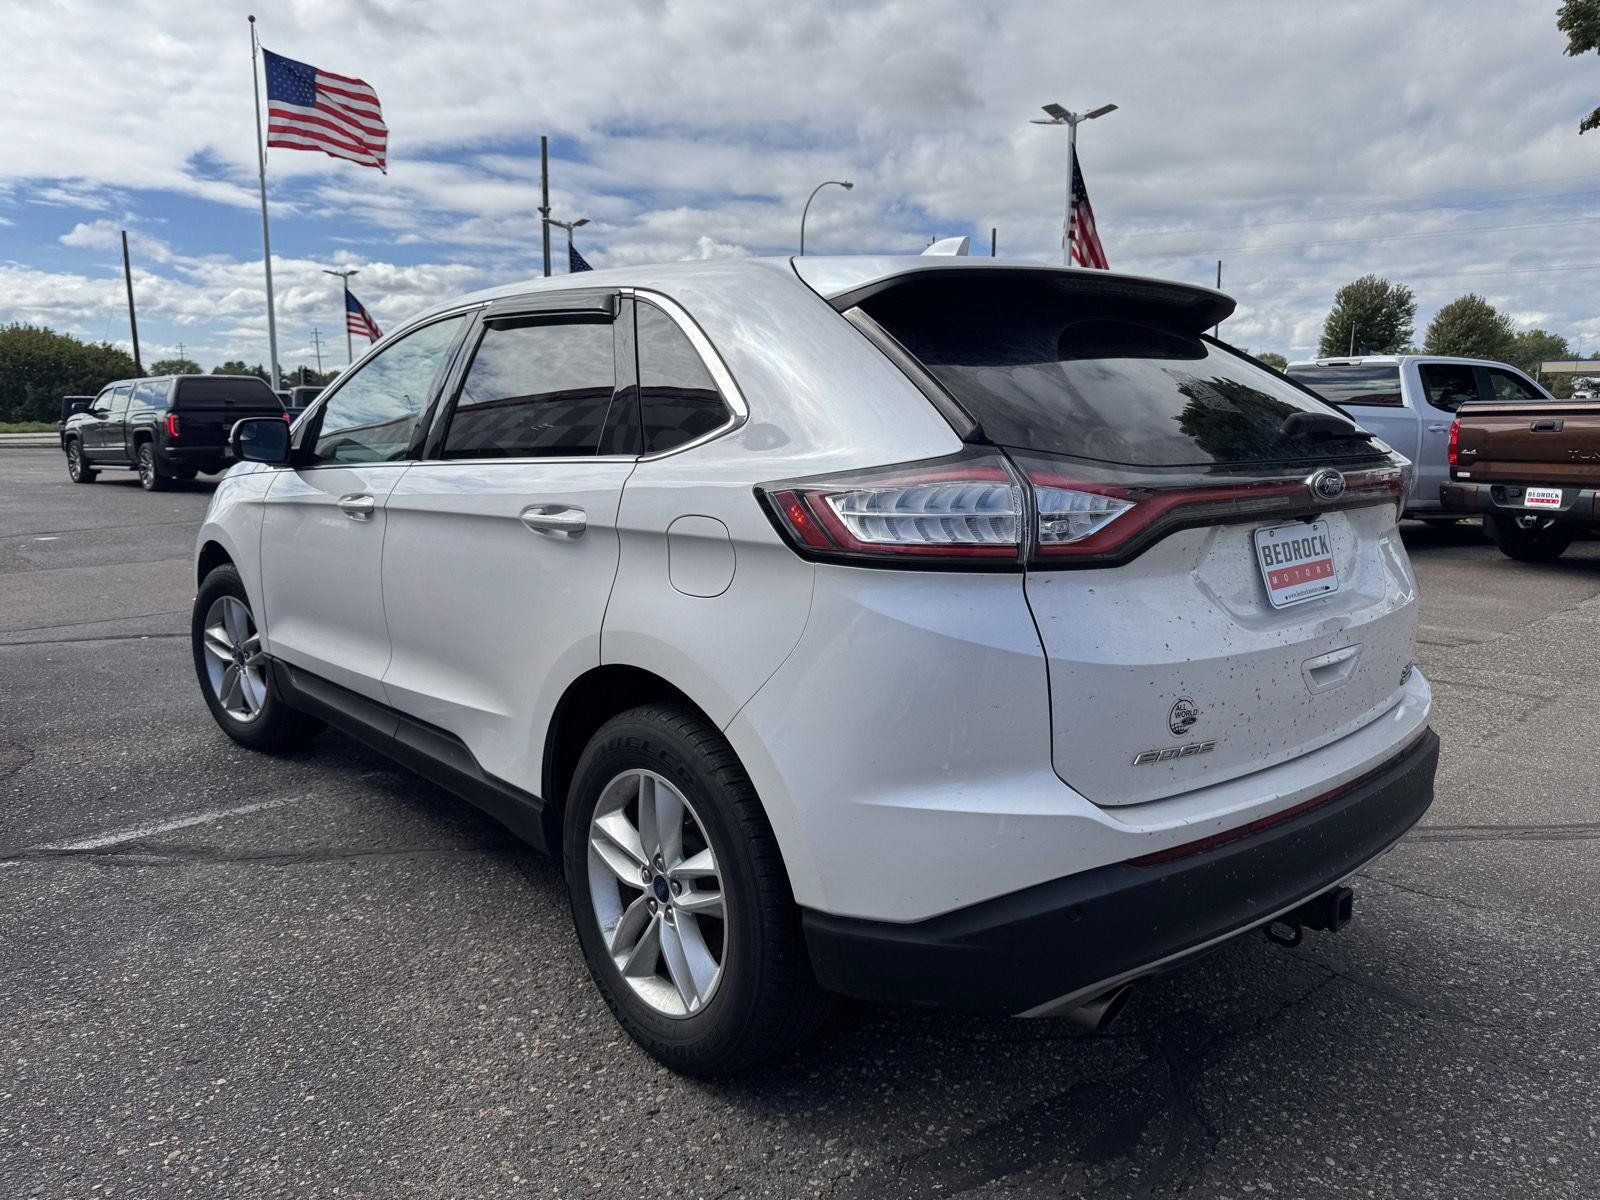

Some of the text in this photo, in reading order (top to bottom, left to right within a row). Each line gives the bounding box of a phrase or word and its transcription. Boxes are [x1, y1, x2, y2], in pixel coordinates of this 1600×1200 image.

[1527, 490, 1560, 499] BEDROCK
[1261, 534, 1330, 567] BEDROCK
[1271, 563, 1331, 584] MOTORS
[1174, 708, 1198, 719] WORLD
[1132, 740, 1218, 765] EDGE
